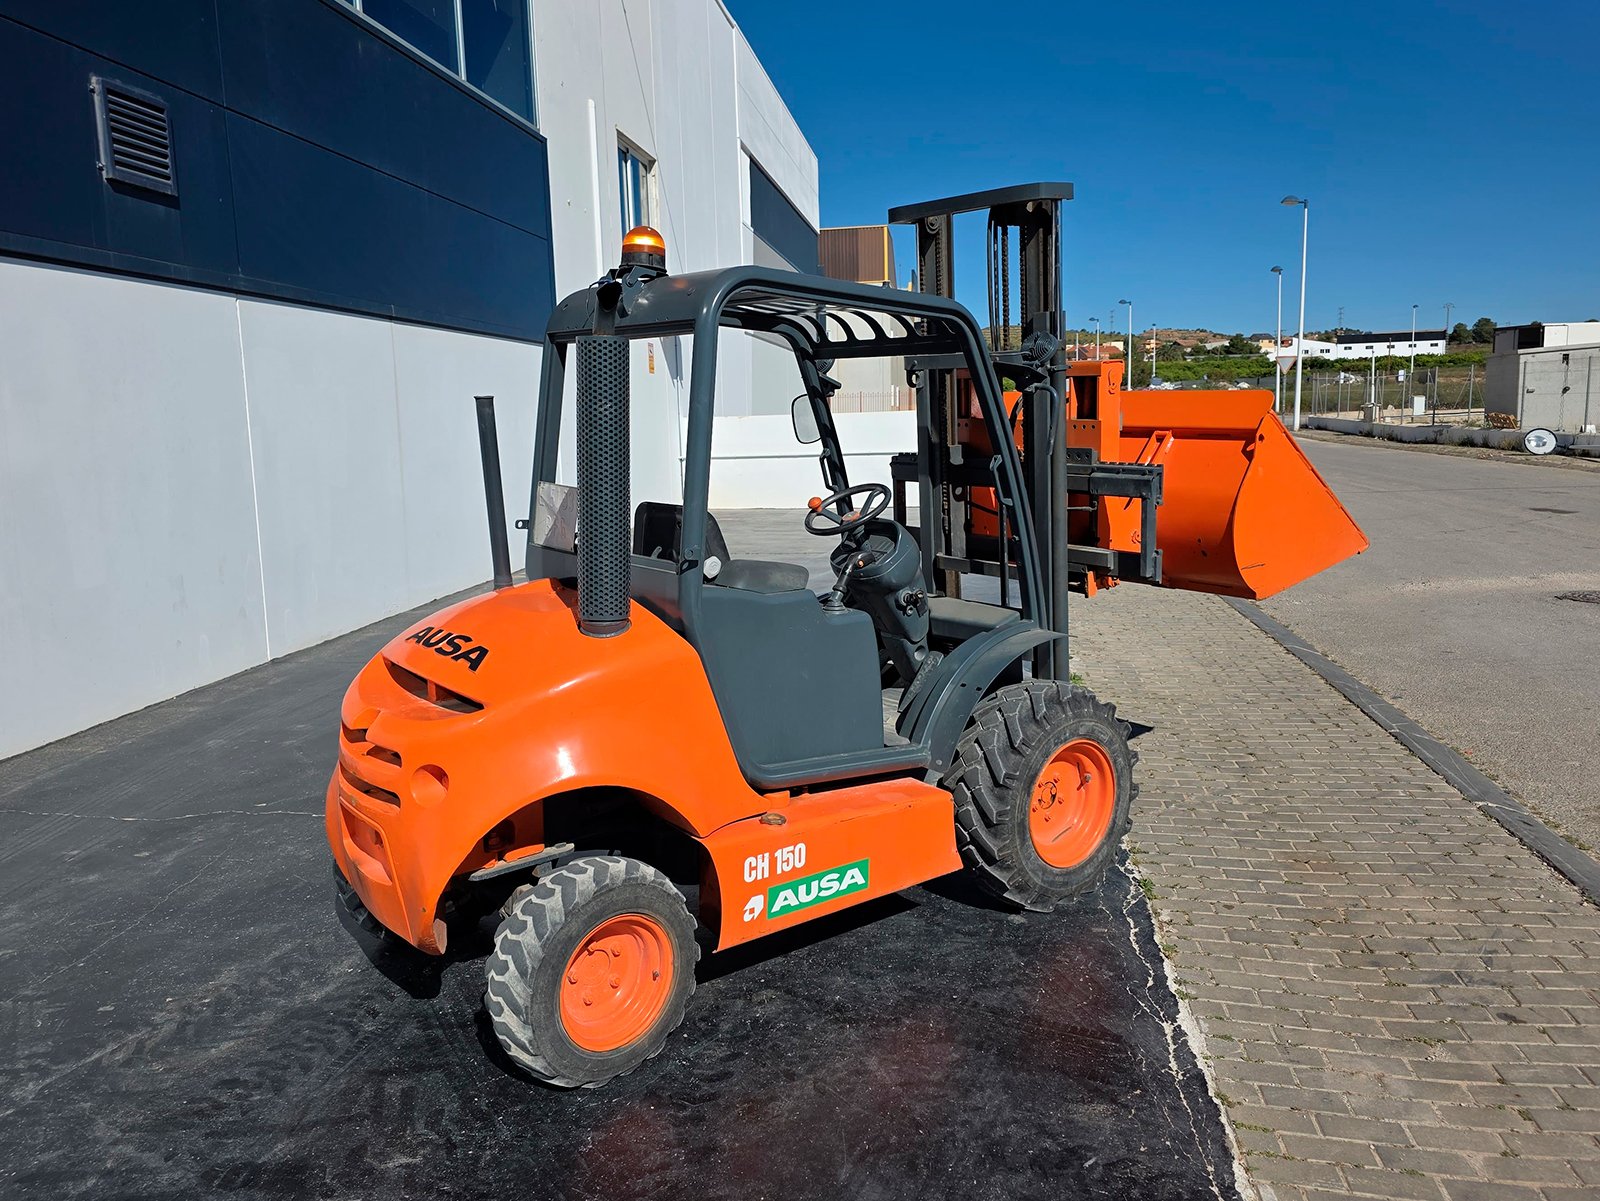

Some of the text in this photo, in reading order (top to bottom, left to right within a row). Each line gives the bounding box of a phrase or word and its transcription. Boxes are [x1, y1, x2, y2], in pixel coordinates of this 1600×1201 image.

[405, 626, 490, 672] AUSA
[743, 842, 806, 883] CH 150
[770, 867, 866, 913] AUSA
